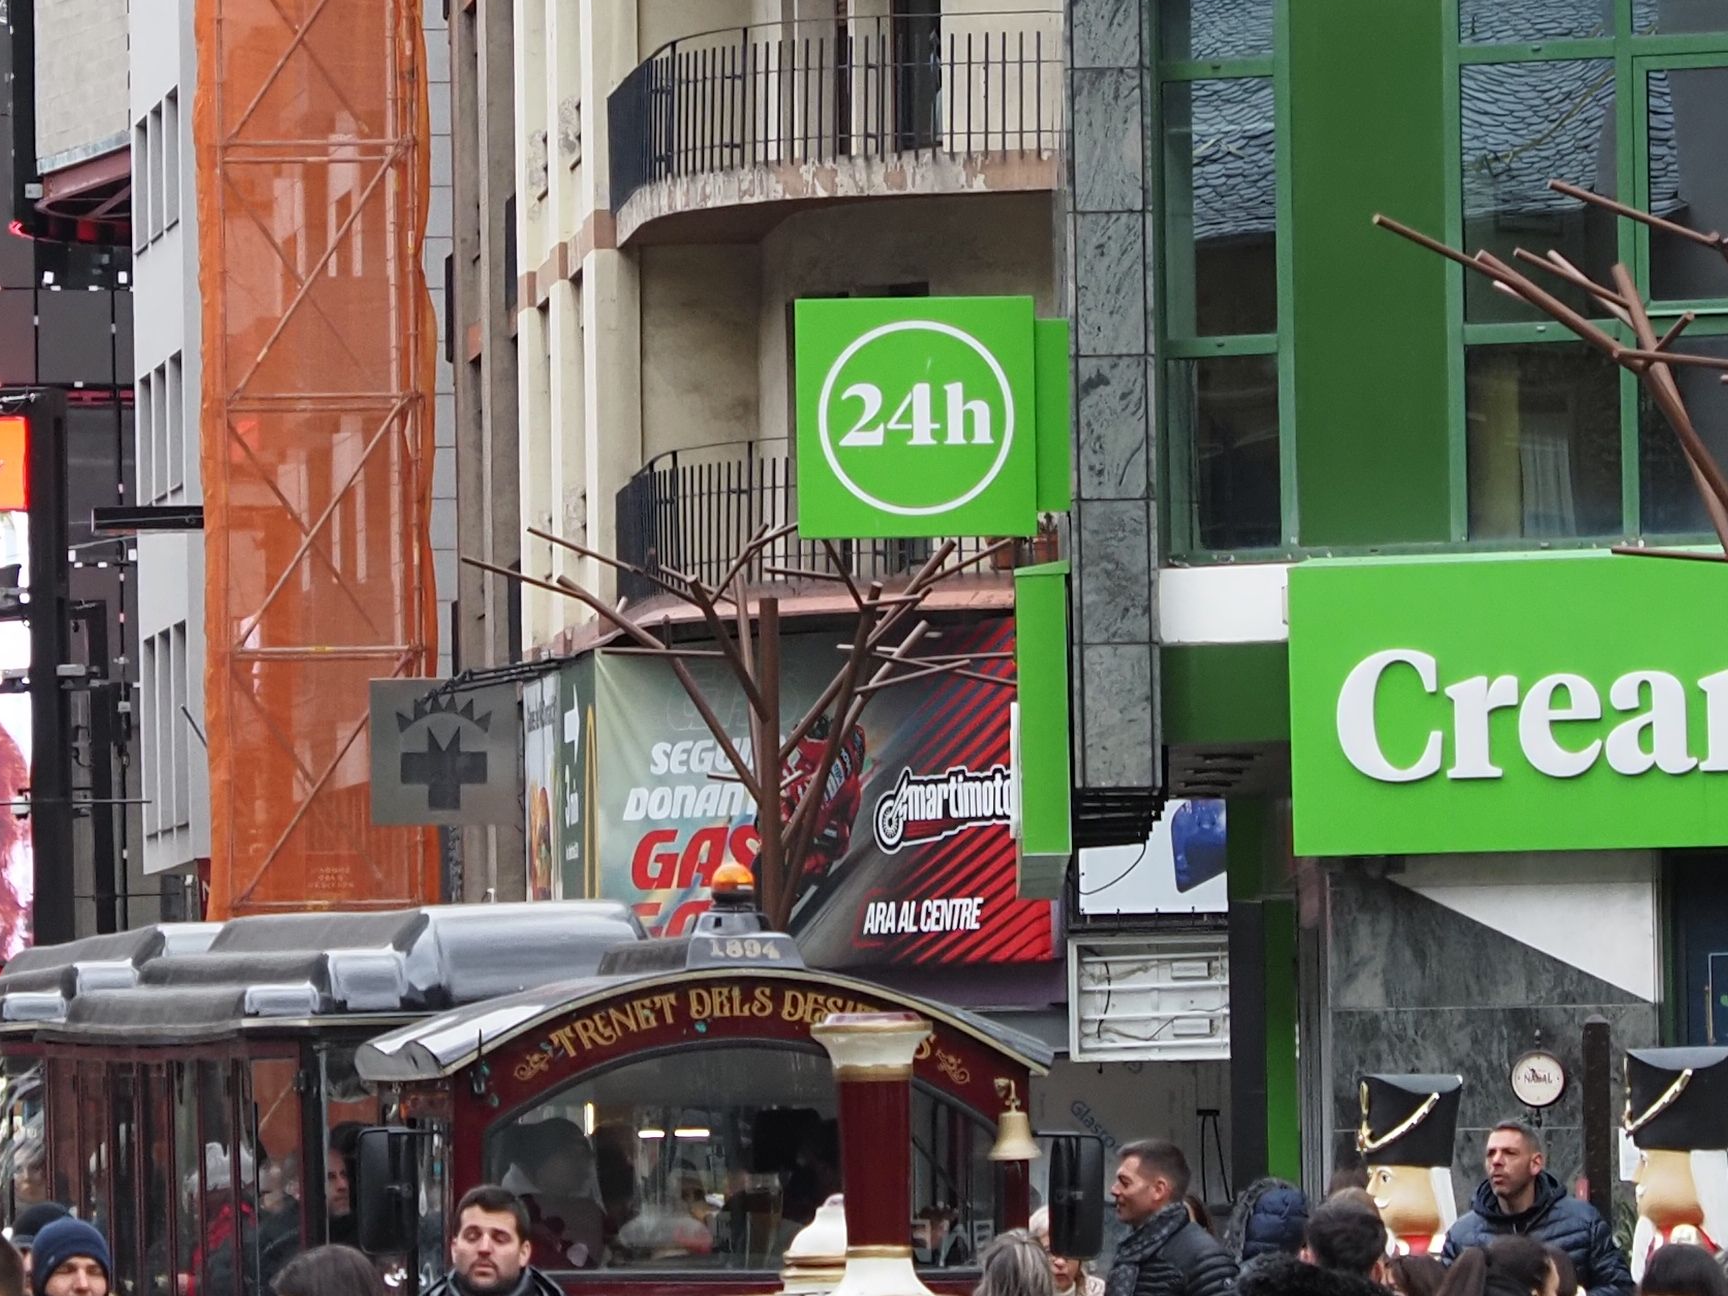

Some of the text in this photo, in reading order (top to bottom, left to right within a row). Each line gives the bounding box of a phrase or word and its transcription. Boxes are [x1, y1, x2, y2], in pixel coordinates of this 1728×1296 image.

[839, 381, 994, 446] 24h
[631, 825, 763, 891] GAS
[863, 897, 985, 935] ARA AL CENTRE
[709, 938, 781, 960] 1894
[550, 992, 678, 1058] TRENET
[688, 986, 774, 1019] DELS
